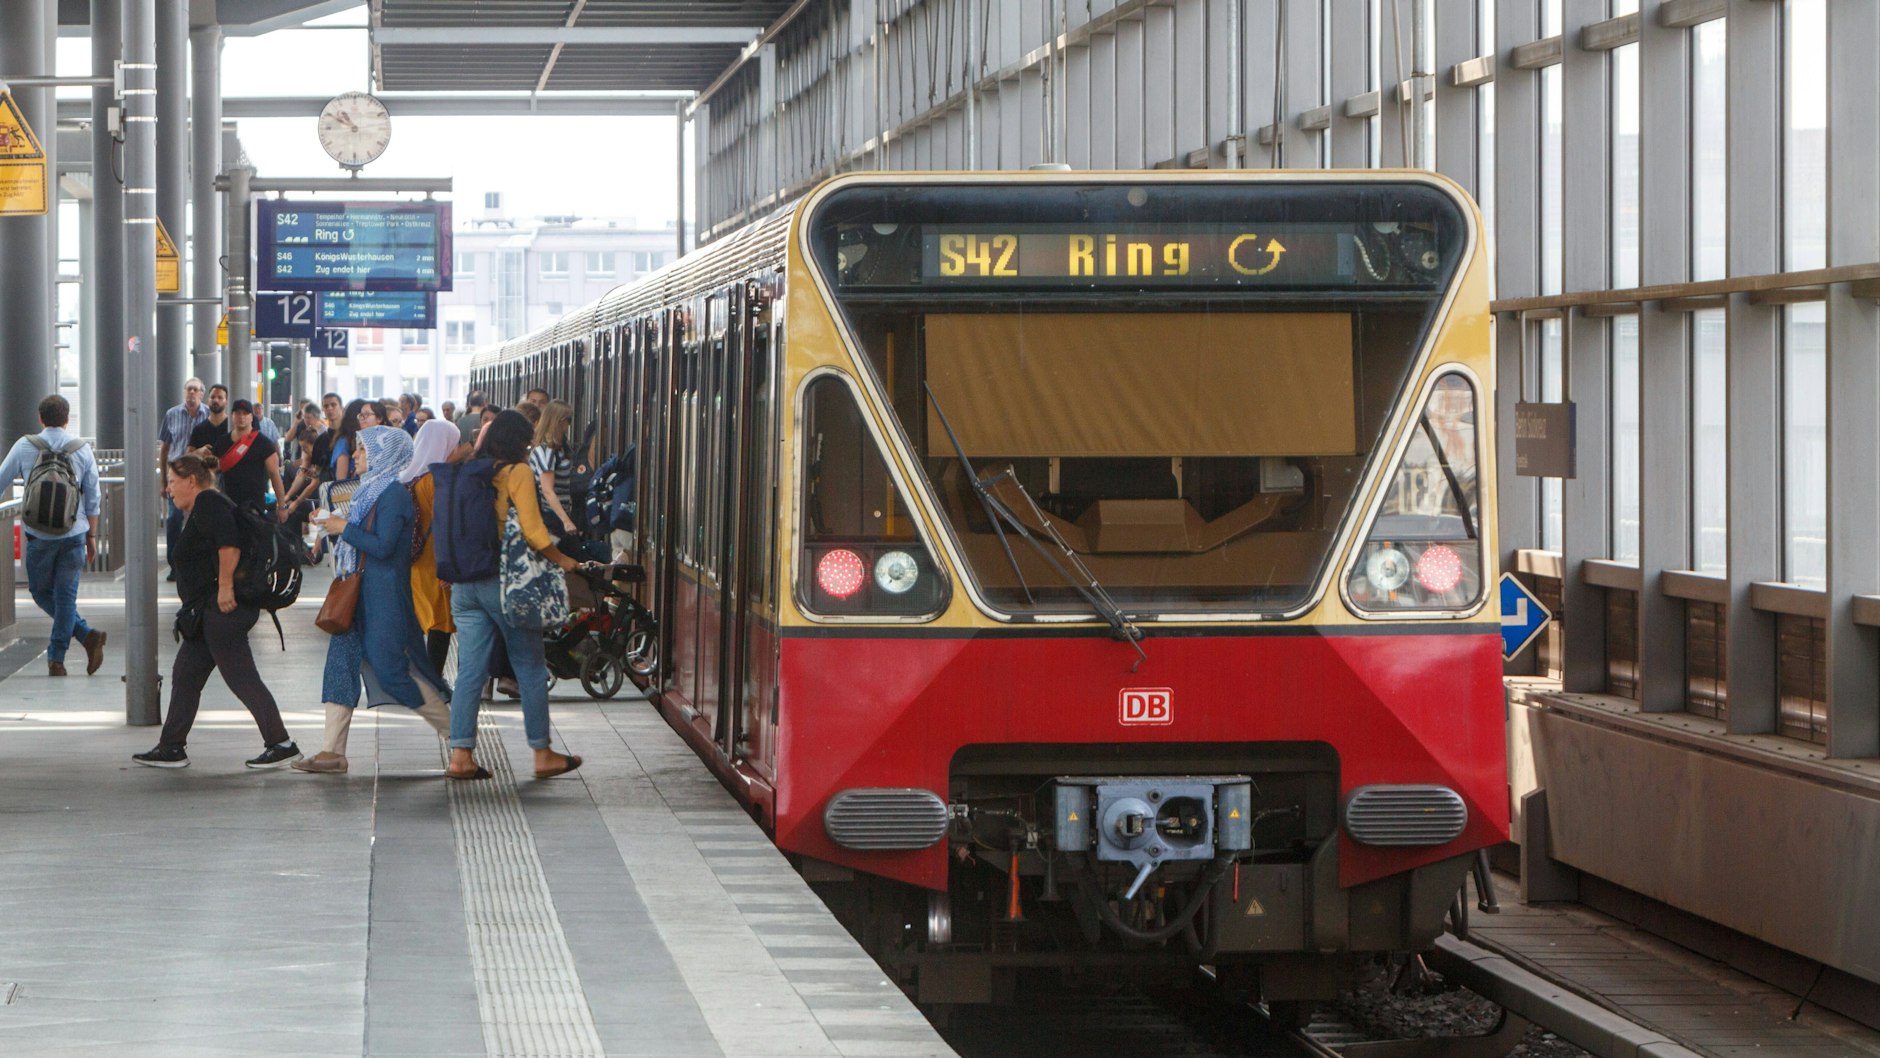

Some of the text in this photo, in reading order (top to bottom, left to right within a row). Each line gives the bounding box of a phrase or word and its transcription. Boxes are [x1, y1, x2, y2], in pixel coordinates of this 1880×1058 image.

[277, 213, 299, 225] S42
[316, 213, 345, 221] Tempelhof
[356, 220, 385, 228] Treptower
[315, 229, 339, 243] Ring
[277, 252, 293, 261] S46
[315, 252, 395, 263] KönigsWusterhausen
[941, 234, 1190, 276] S42 Ring
[277, 265, 293, 273] S42
[315, 265, 330, 275] Zug
[332, 265, 355, 274] endet
[357, 265, 372, 274] hier
[277, 295, 311, 325] 12
[324, 330, 346, 349] 12
[1127, 694, 1167, 719] DB
